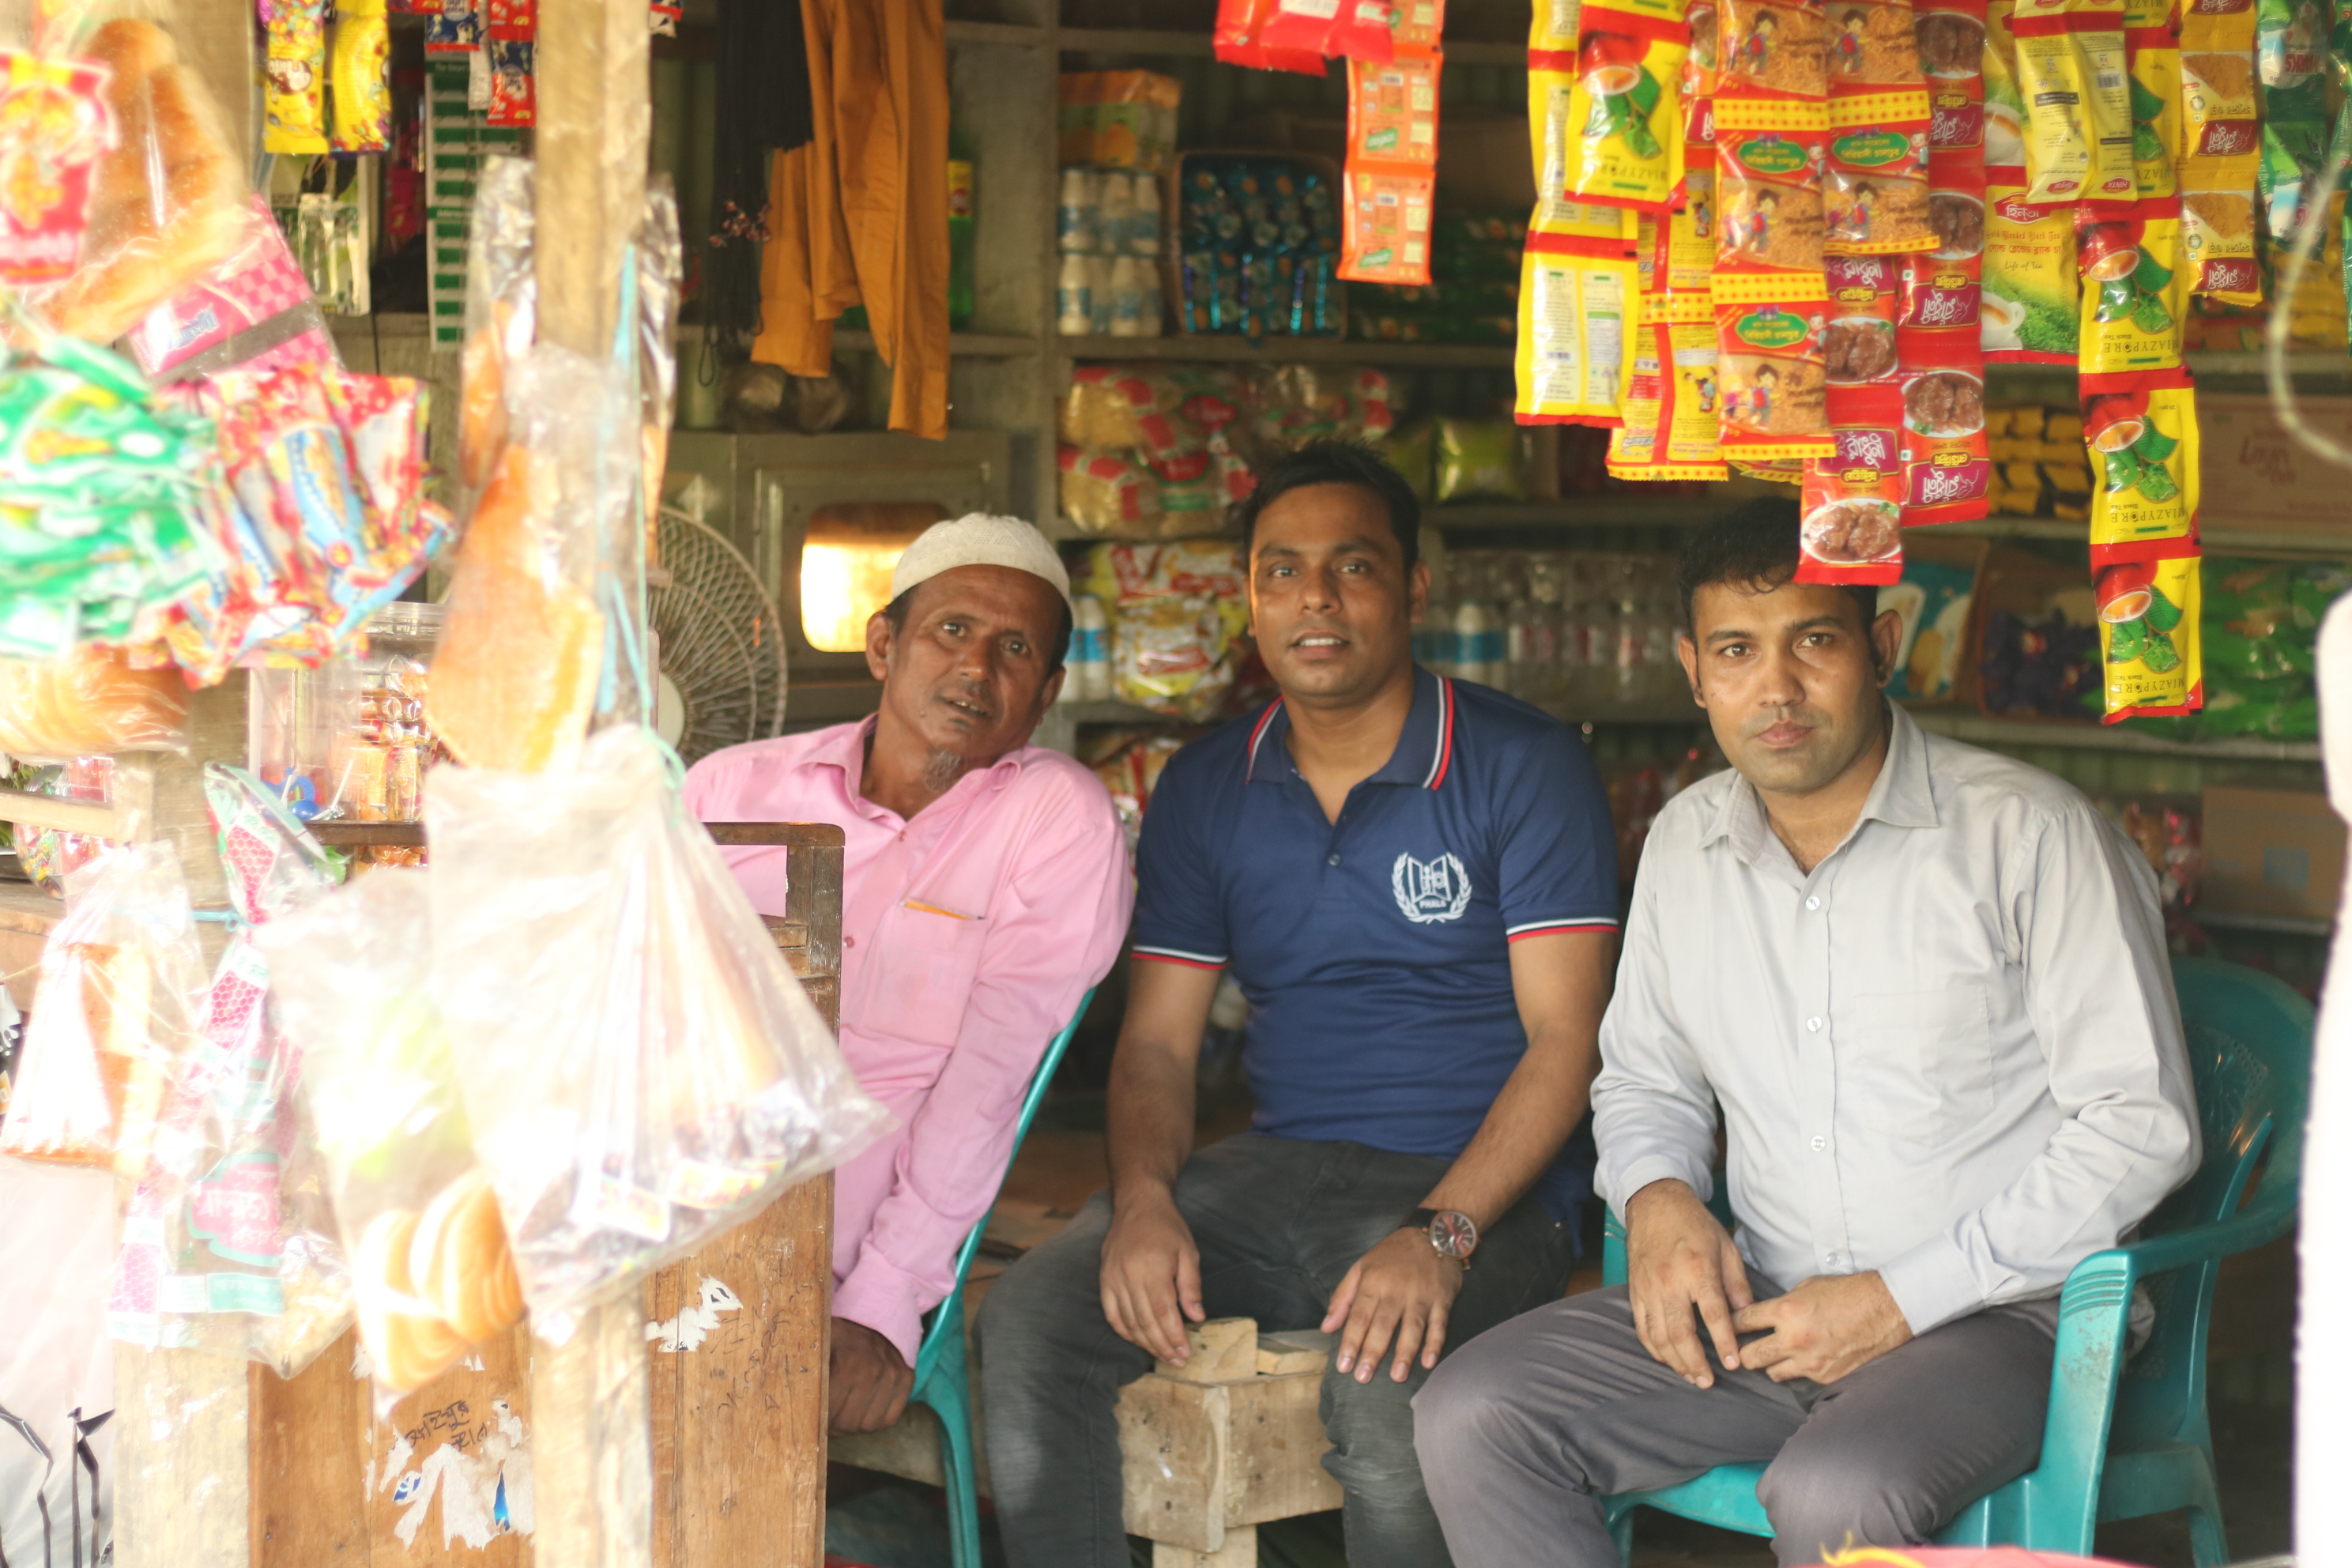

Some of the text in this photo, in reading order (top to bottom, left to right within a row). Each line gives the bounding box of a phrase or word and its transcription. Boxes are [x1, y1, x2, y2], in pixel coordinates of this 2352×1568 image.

[2049, 232, 2060, 241] Tea
[2005, 261, 2018, 271] Life
[2021, 262, 2029, 271] of
[1846, 431, 1886, 469] রাঁধুনী
[1921, 468, 1959, 503] রাঁধুনী
[2111, 508, 2186, 522] MIAZYPORE
[2115, 678, 2184, 693] MIAZYPORE
